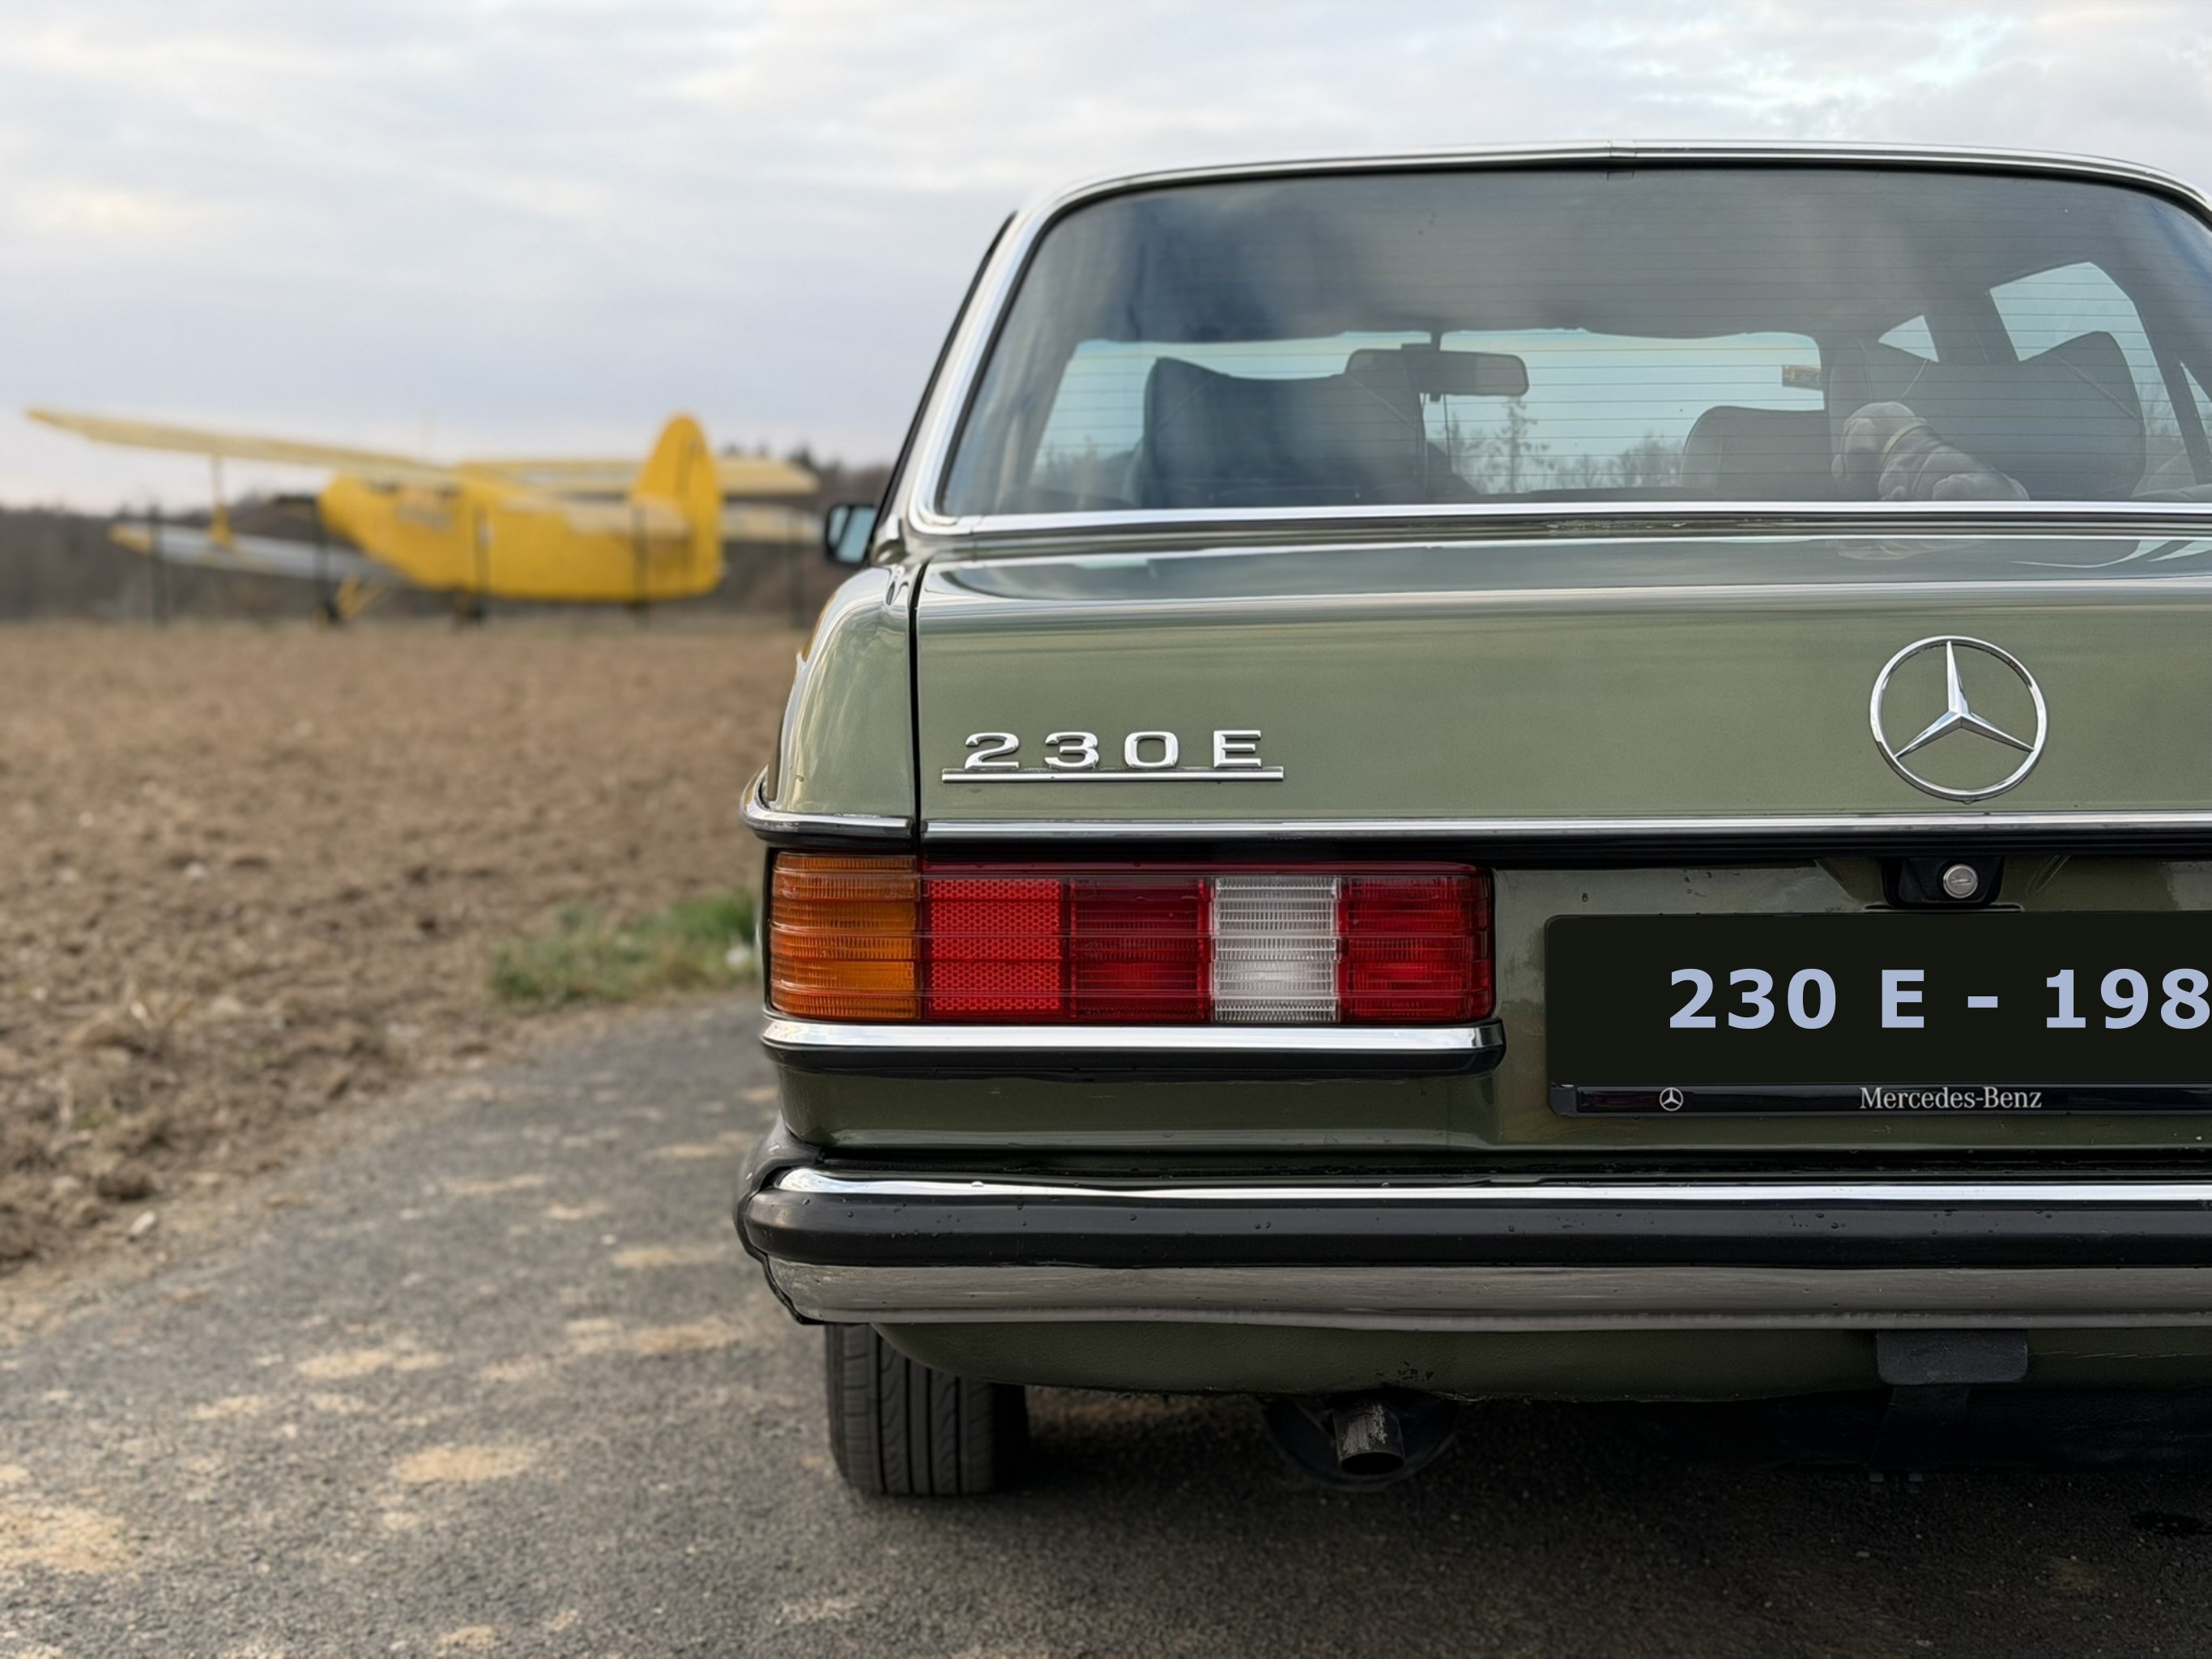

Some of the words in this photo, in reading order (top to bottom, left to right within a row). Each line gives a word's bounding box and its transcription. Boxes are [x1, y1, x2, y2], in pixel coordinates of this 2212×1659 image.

[1669, 968, 1836, 1030] 230
[1882, 969, 1924, 1029] E
[2046, 968, 2210, 1030] 198
[1859, 1085, 2042, 1109] Mercedes-Benz
